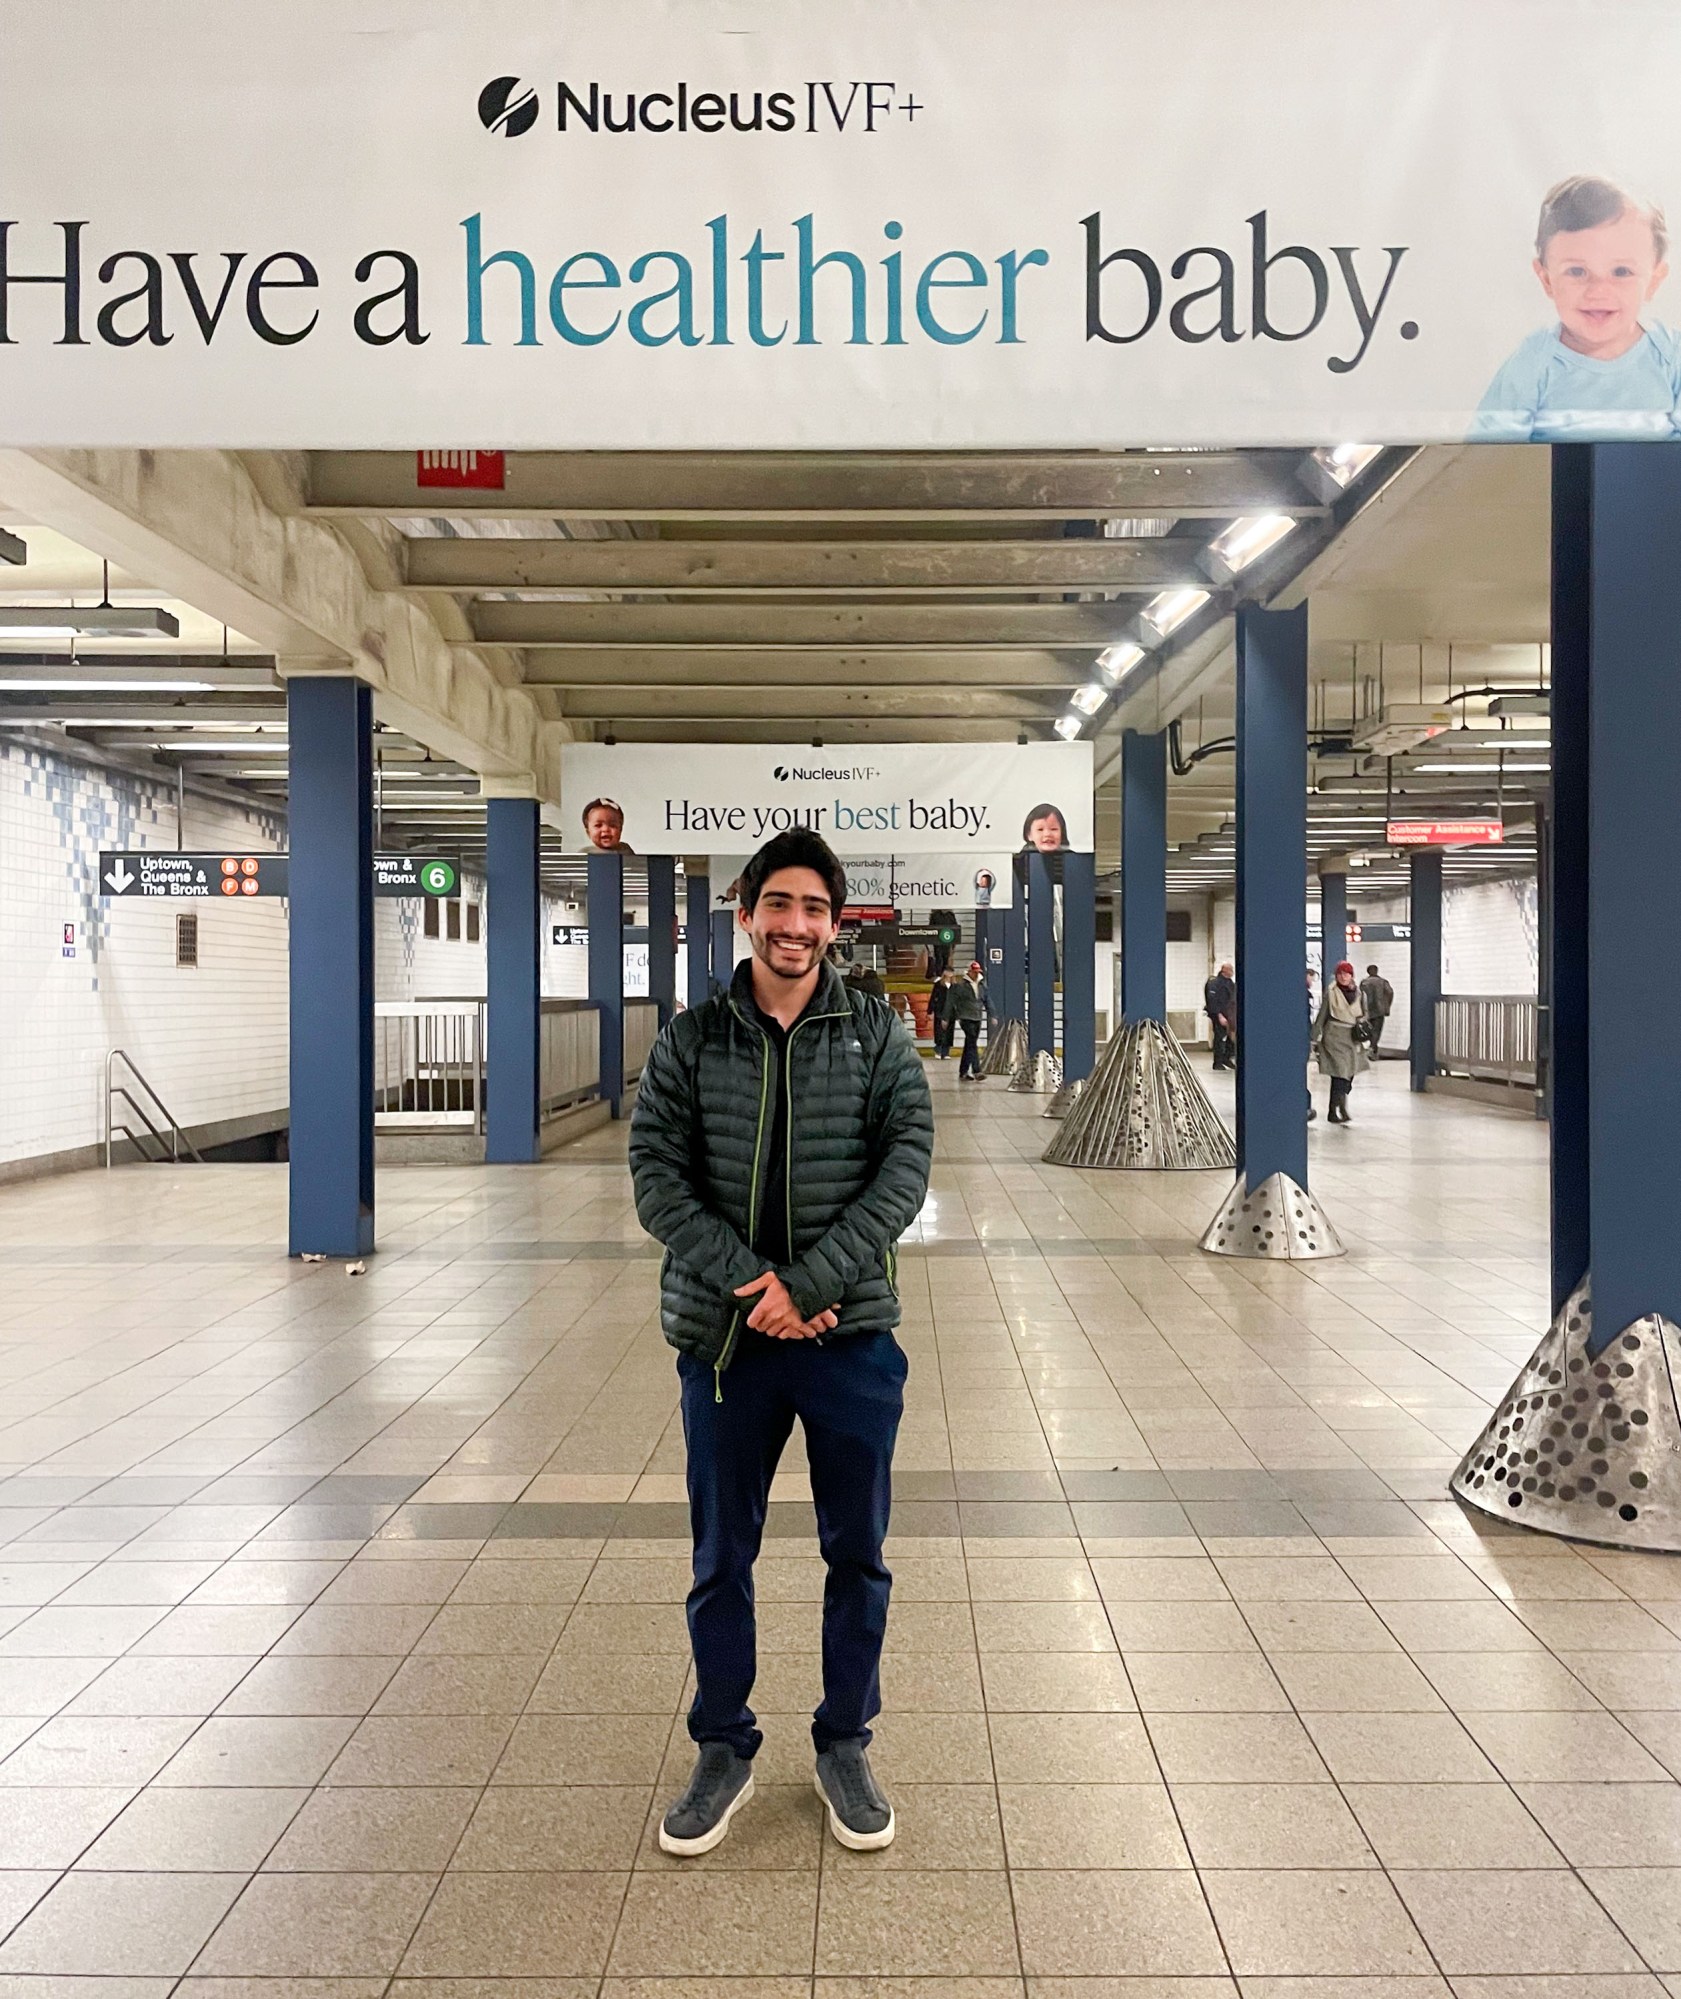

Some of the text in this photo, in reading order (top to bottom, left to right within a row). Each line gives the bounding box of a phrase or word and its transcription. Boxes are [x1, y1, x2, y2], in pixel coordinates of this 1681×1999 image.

[557, 81, 925, 133] Nucleus IVF+
[0, 209, 1420, 374] Have a healthier baby.
[792, 767, 851, 781] Nucleus
[665, 798, 991, 839] Have your best baby.
[140, 857, 193, 871] Uptown,
[402, 858, 413, 871] &
[140, 869, 207, 883] Queens &
[378, 871, 417, 884] Bronx
[429, 867, 446, 888] 6
[140, 883, 209, 895] The Bronx
[888, 878, 959, 900] genetic.
